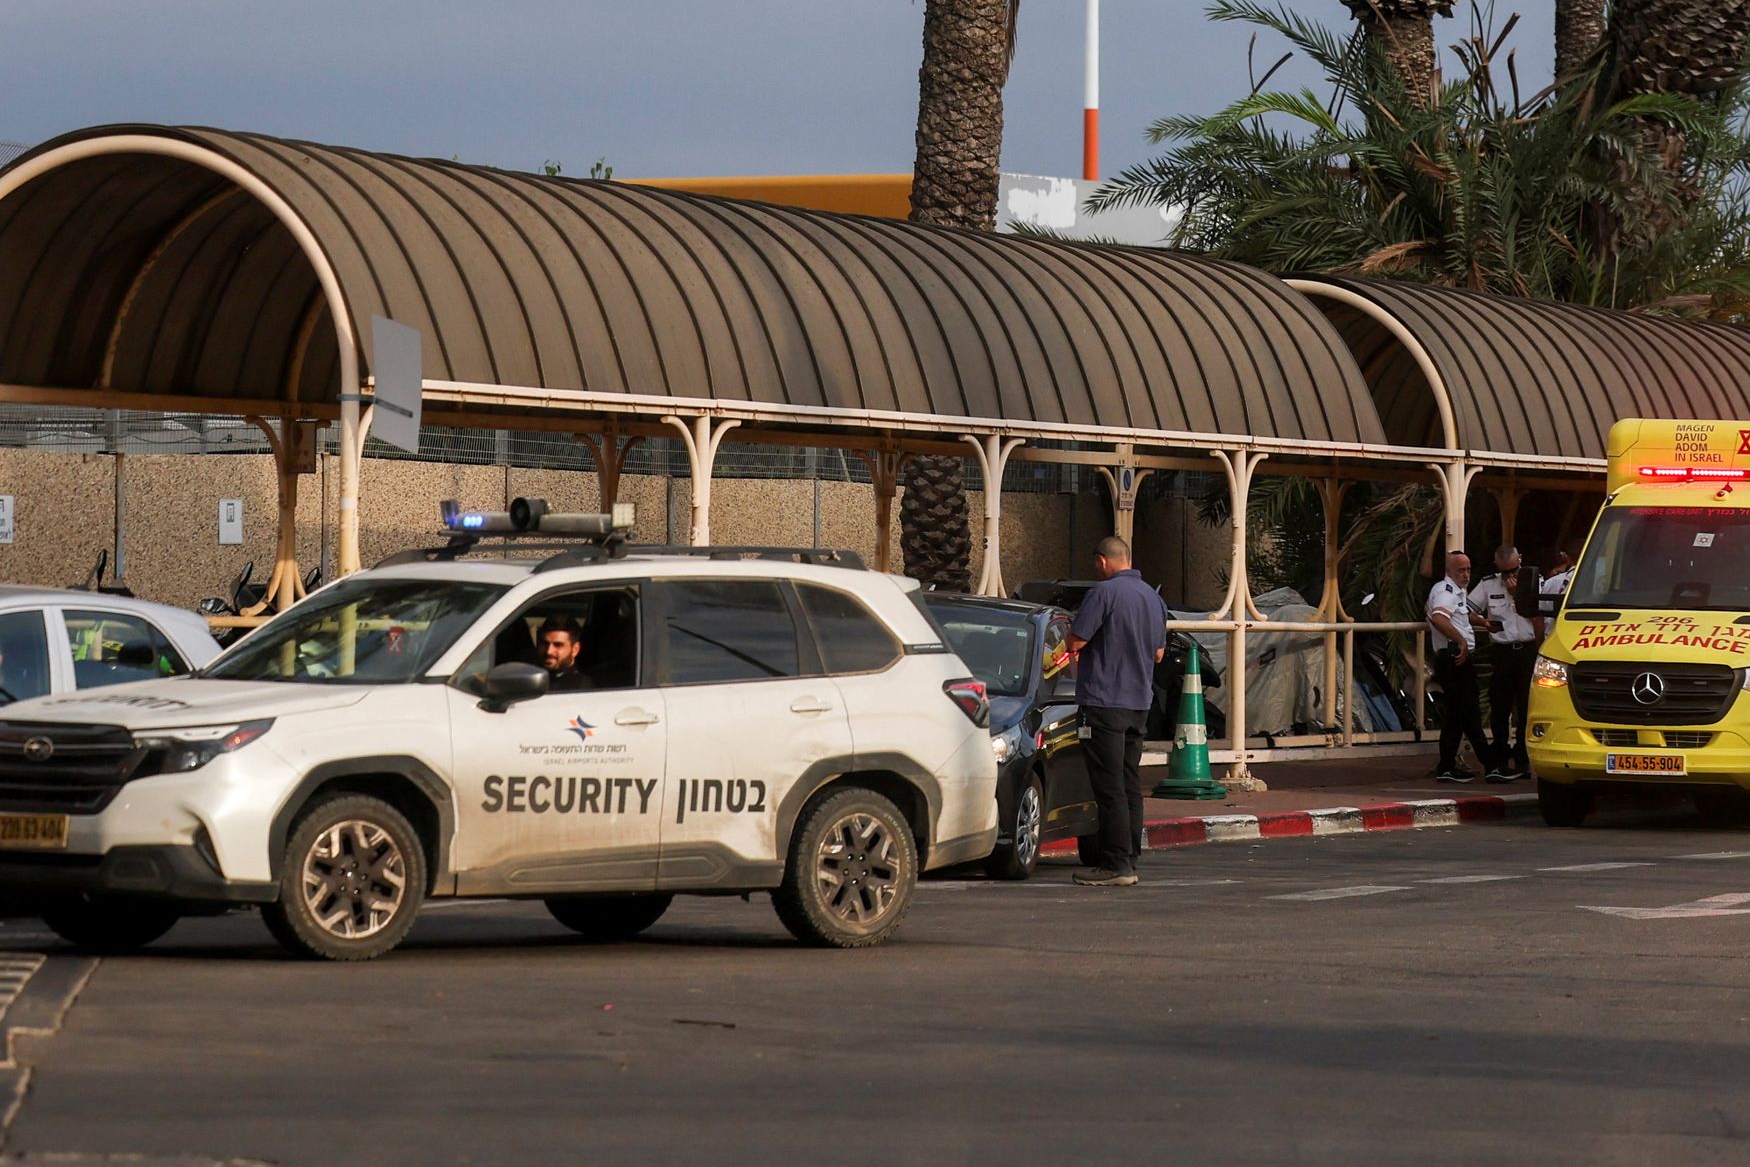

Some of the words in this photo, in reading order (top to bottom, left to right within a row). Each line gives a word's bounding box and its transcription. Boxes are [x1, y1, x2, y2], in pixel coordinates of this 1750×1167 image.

[1676, 424, 1715, 432] MAGEN
[1675, 433, 1708, 442] DAVID
[1675, 443, 1708, 452] ADOM
[1674, 453, 1687, 462] IN
[1689, 453, 1724, 463] ISRAEL
[1646, 616, 1694, 624] 206
[1579, 623, 1641, 636] אדום
[1655, 623, 1700, 633] דוד
[1571, 633, 1749, 654] AMBULANCE
[519, 743, 549, 755] בישראל
[481, 774, 658, 814] SECURITY
[675, 778, 767, 824] בטחון
